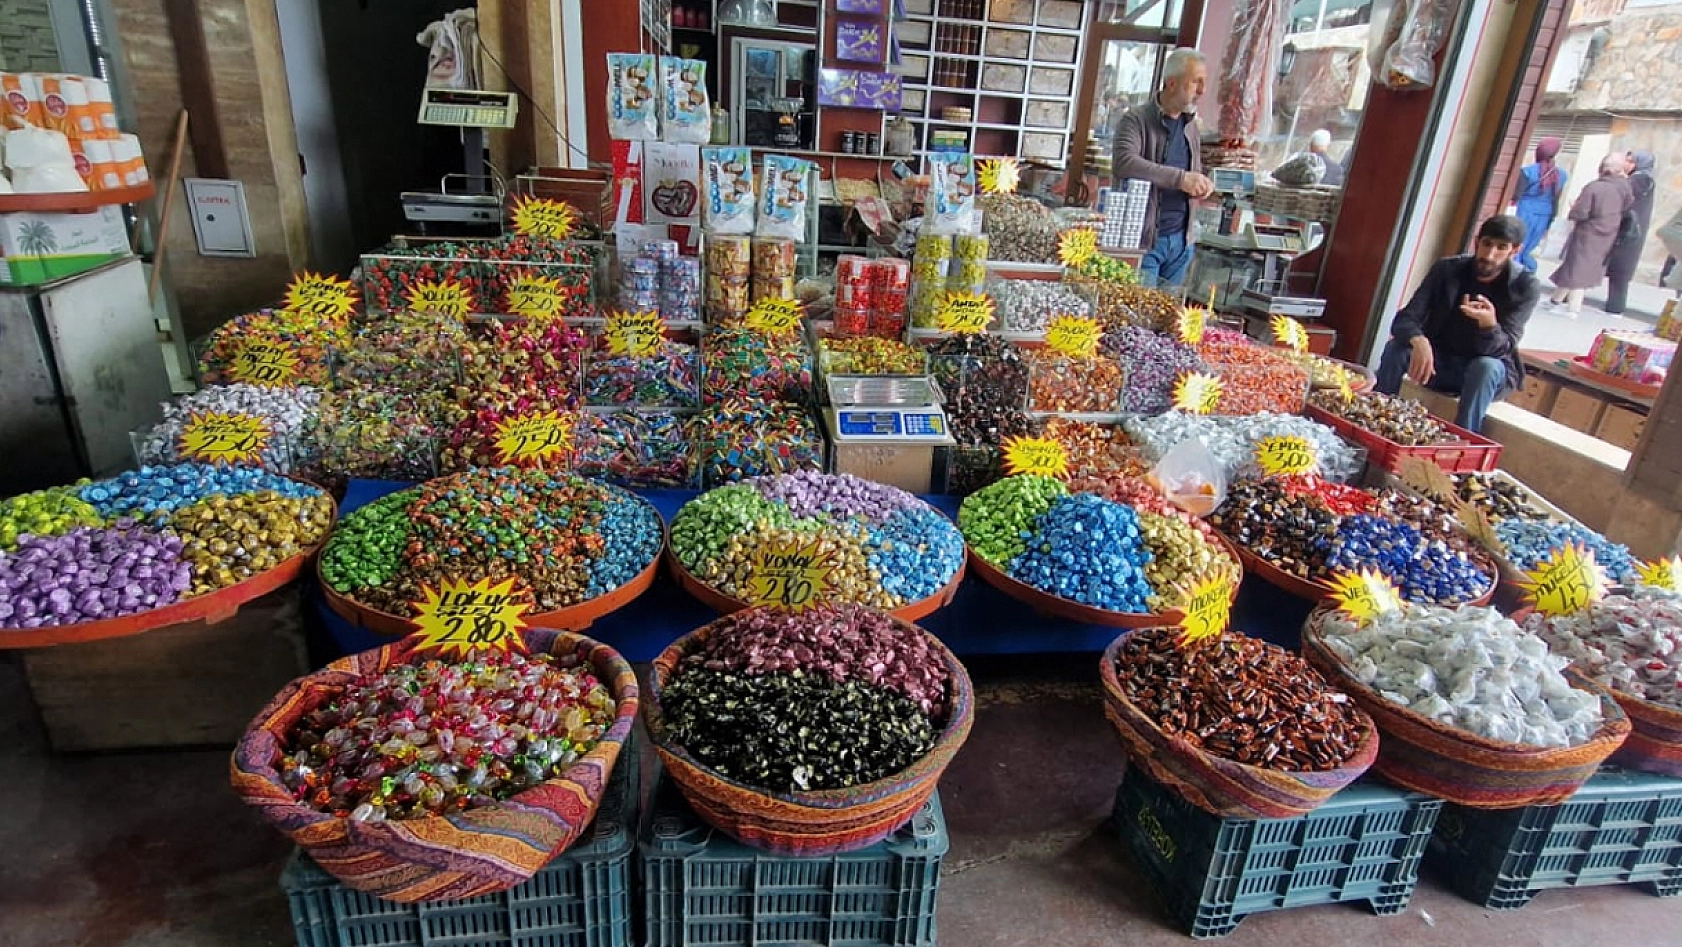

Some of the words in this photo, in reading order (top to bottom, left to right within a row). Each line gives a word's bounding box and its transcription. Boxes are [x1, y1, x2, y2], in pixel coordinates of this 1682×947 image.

[194, 431, 258, 452] 250
[509, 424, 562, 457] 250
[1274, 452, 1311, 469] 300
[761, 577, 813, 606] 280
[435, 616, 507, 643] 280
